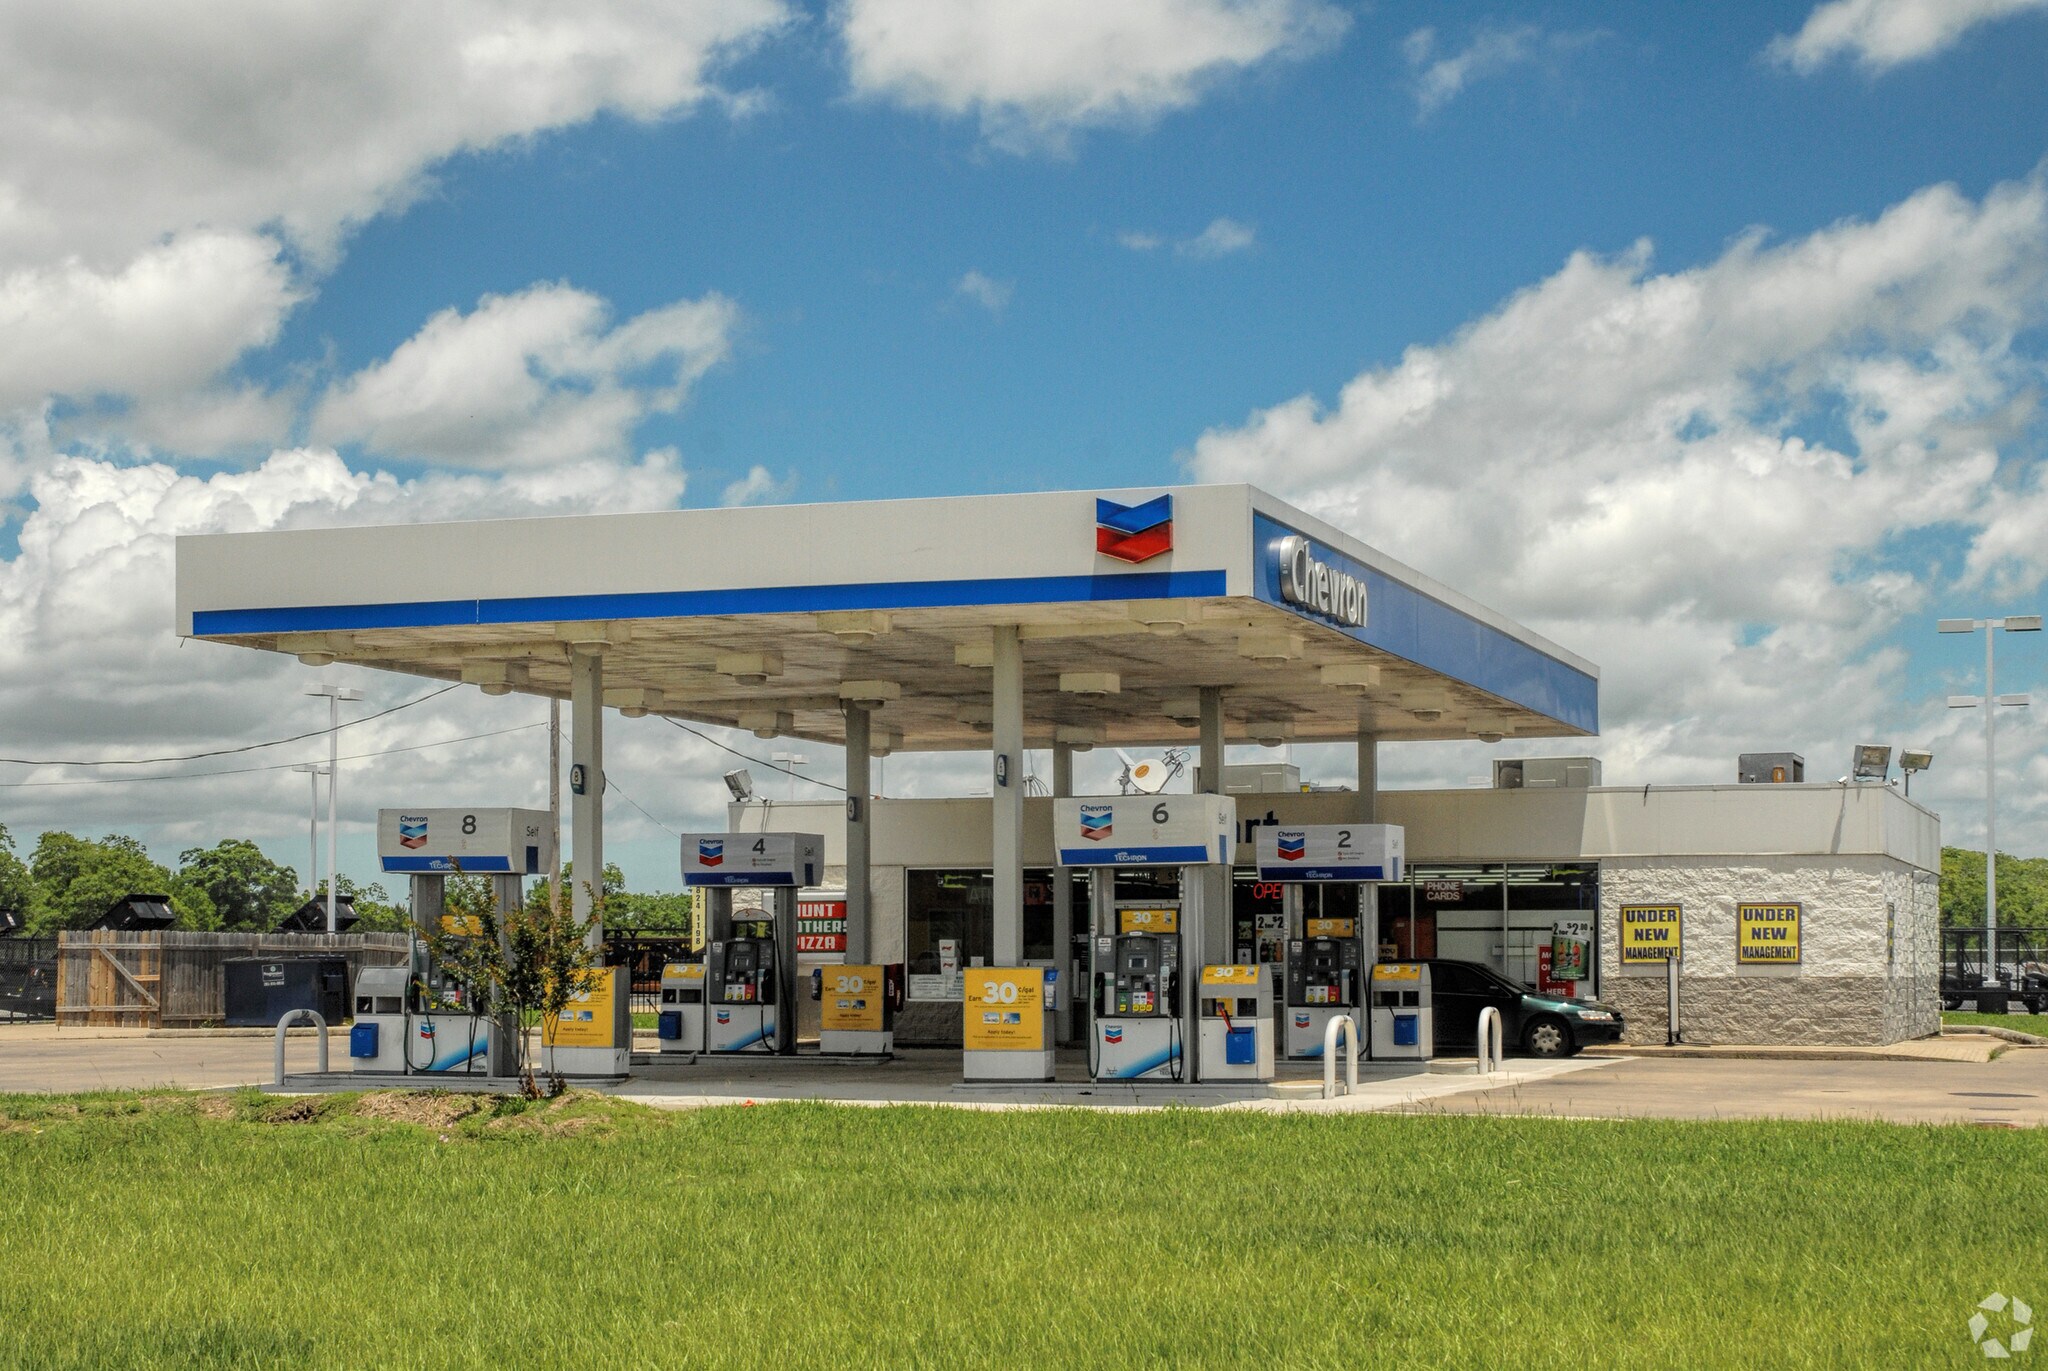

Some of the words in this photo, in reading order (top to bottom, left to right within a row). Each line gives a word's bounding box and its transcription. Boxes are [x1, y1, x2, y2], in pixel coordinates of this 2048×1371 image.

[1280, 535, 1367, 628] Chevron
[1080, 804, 1113, 812] Chevron
[1152, 802, 1169, 824] 6
[461, 814, 477, 835] 8
[526, 825, 540, 837] Self
[1236, 810, 1279, 843] rt
[699, 838, 723, 846] Chevron
[1337, 830, 1351, 848] 2
[752, 838, 766, 855] 4
[1253, 882, 1283, 899] OPE
[1426, 882, 1460, 890] PHONE
[1426, 892, 1460, 900] CARDS
[1133, 912, 1151, 923] 30
[1626, 909, 1677, 923] UNDER
[1743, 908, 1796, 922] UNDER
[1258, 916, 1264, 928] 2
[1317, 920, 1333, 930] 30
[1553, 922, 1559, 935] 2
[1634, 928, 1669, 941] NEW
[1751, 927, 1787, 940] NEW
[797, 936, 836, 950] IZZA
[1625, 946, 1679, 959] MANAGEMENT
[1742, 945, 1797, 959] MANAGEMENT
[673, 965, 688, 973] 30
[1214, 966, 1234, 977] 30
[1383, 965, 1401, 973] 30
[836, 975, 864, 993] 30
[983, 981, 1018, 1004] 30
